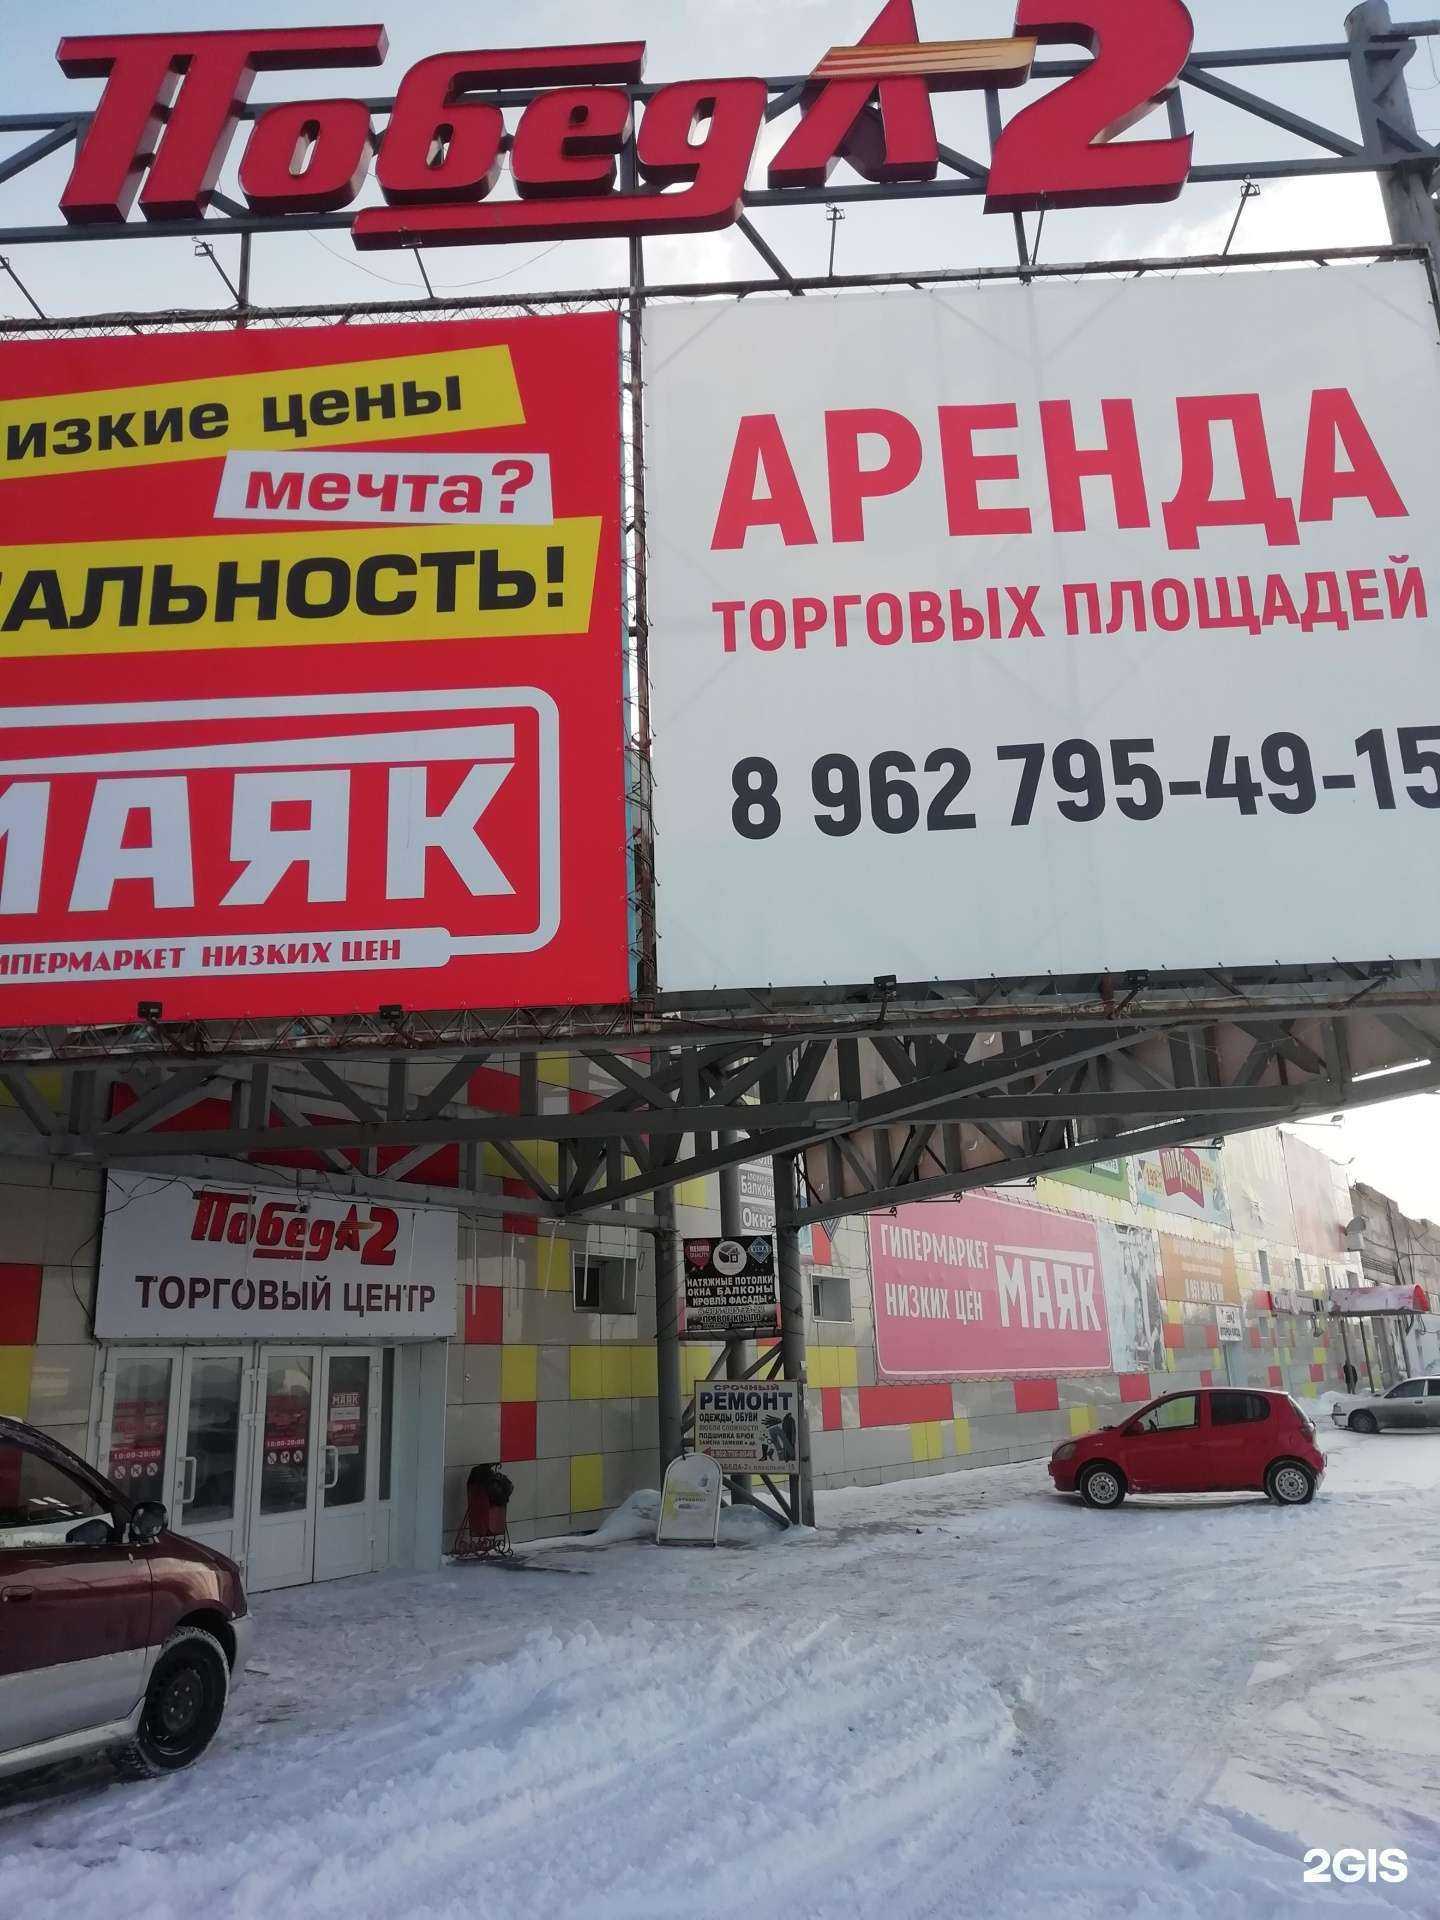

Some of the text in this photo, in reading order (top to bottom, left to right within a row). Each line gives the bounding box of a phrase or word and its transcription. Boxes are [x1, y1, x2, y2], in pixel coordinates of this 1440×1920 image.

[262, 375, 463, 438] цены
[244, 459, 535, 514] мечта?
[711, 387, 1410, 551] АРЕНДА
[0, 545, 566, 632] АЛЬНОСТЬ!
[711, 555, 1428, 653] ТОРГОВЫХ ПЛОЩАДЕЙ
[731, 725, 1440, 840] 8 962 795-49-15
[202, 941, 331, 968] НИЗКИХ
[341, 939, 402, 964] ЦЕН
[134, 1275, 436, 1318] ТОРГОВЫЙ ЦЕНТР
[687, 1275, 774, 1288] НАТЯЖНЫЕ ПОТОЛКИ
[687, 1285, 774, 1297] ОКНА БАЛКОНЫ
[880, 1223, 1102, 1332] ГИПЕРМАРКЕТ МАЯК
[692, 1294, 768, 1306] КРОВЛЯ ФАСАДЫ
[884, 1282, 984, 1326] НИЗКИХ ЦЕН
[700, 1391, 793, 1411] РЕМОНТ
[734, 1411, 758, 1422] ОБУВИ
